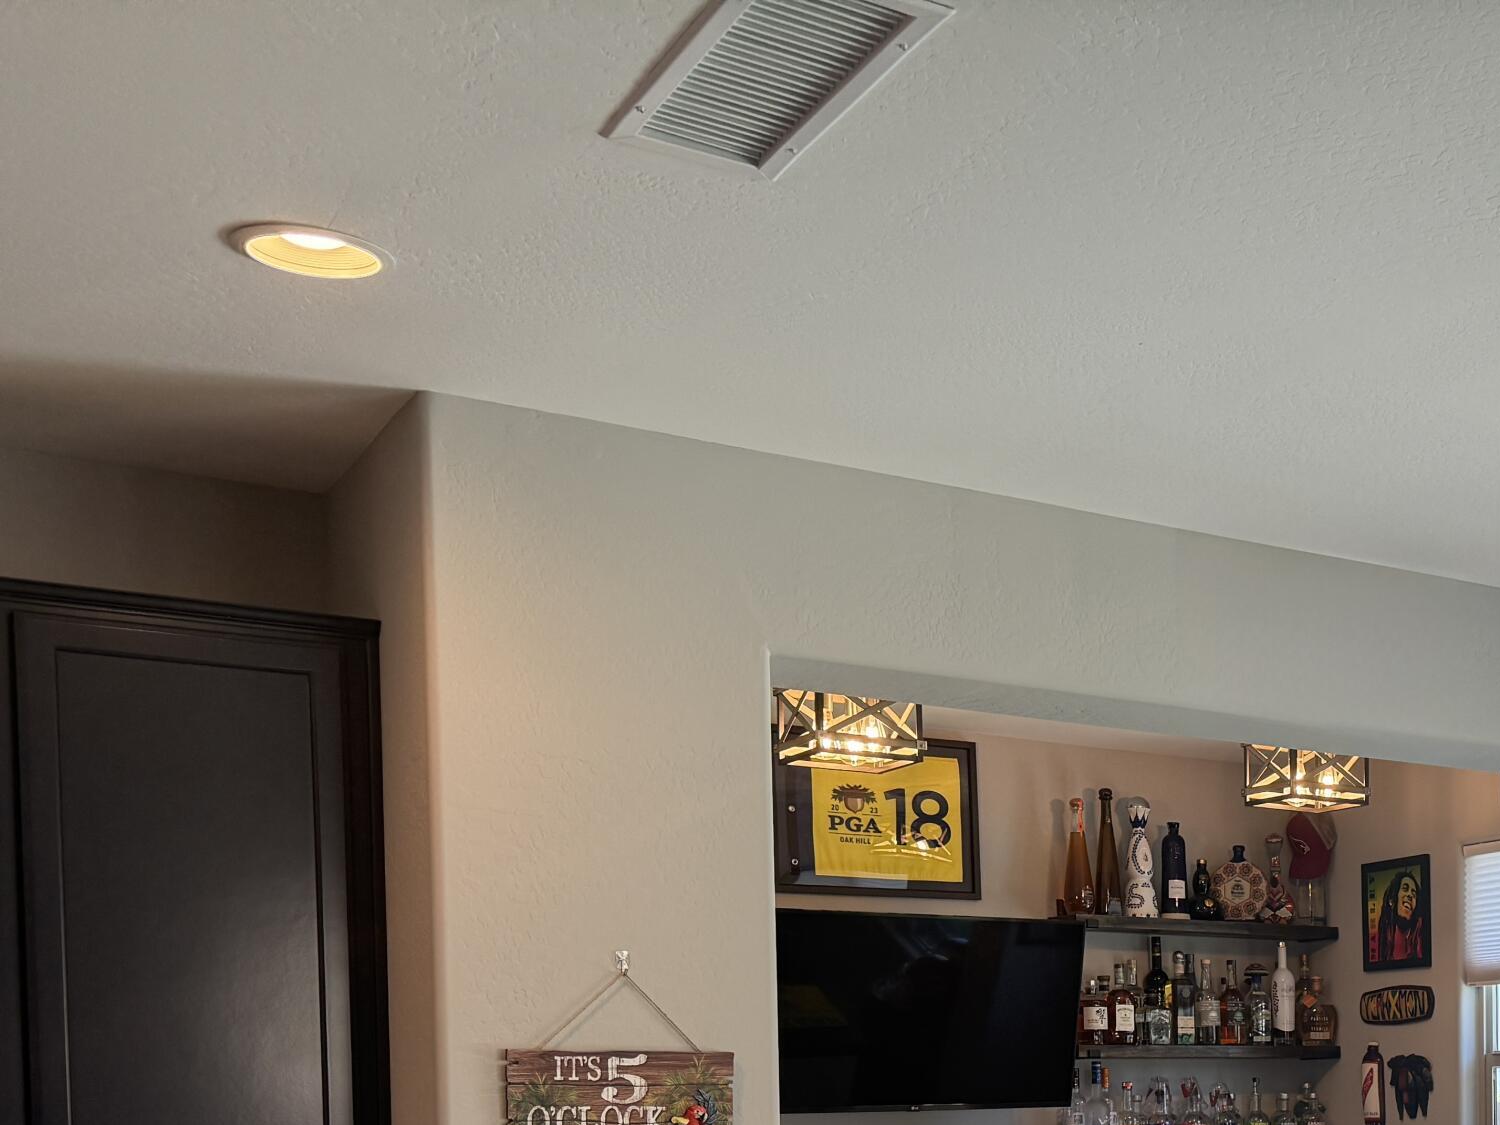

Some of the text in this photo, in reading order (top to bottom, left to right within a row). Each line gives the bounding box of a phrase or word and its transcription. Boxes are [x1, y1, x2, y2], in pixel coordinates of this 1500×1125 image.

[831, 803, 879, 814] 20 23
[883, 788, 952, 848] 18
[828, 814, 882, 834] PGA
[840, 836, 871, 845] OAK HILL
[553, 1053, 648, 1105] IT'S 5
